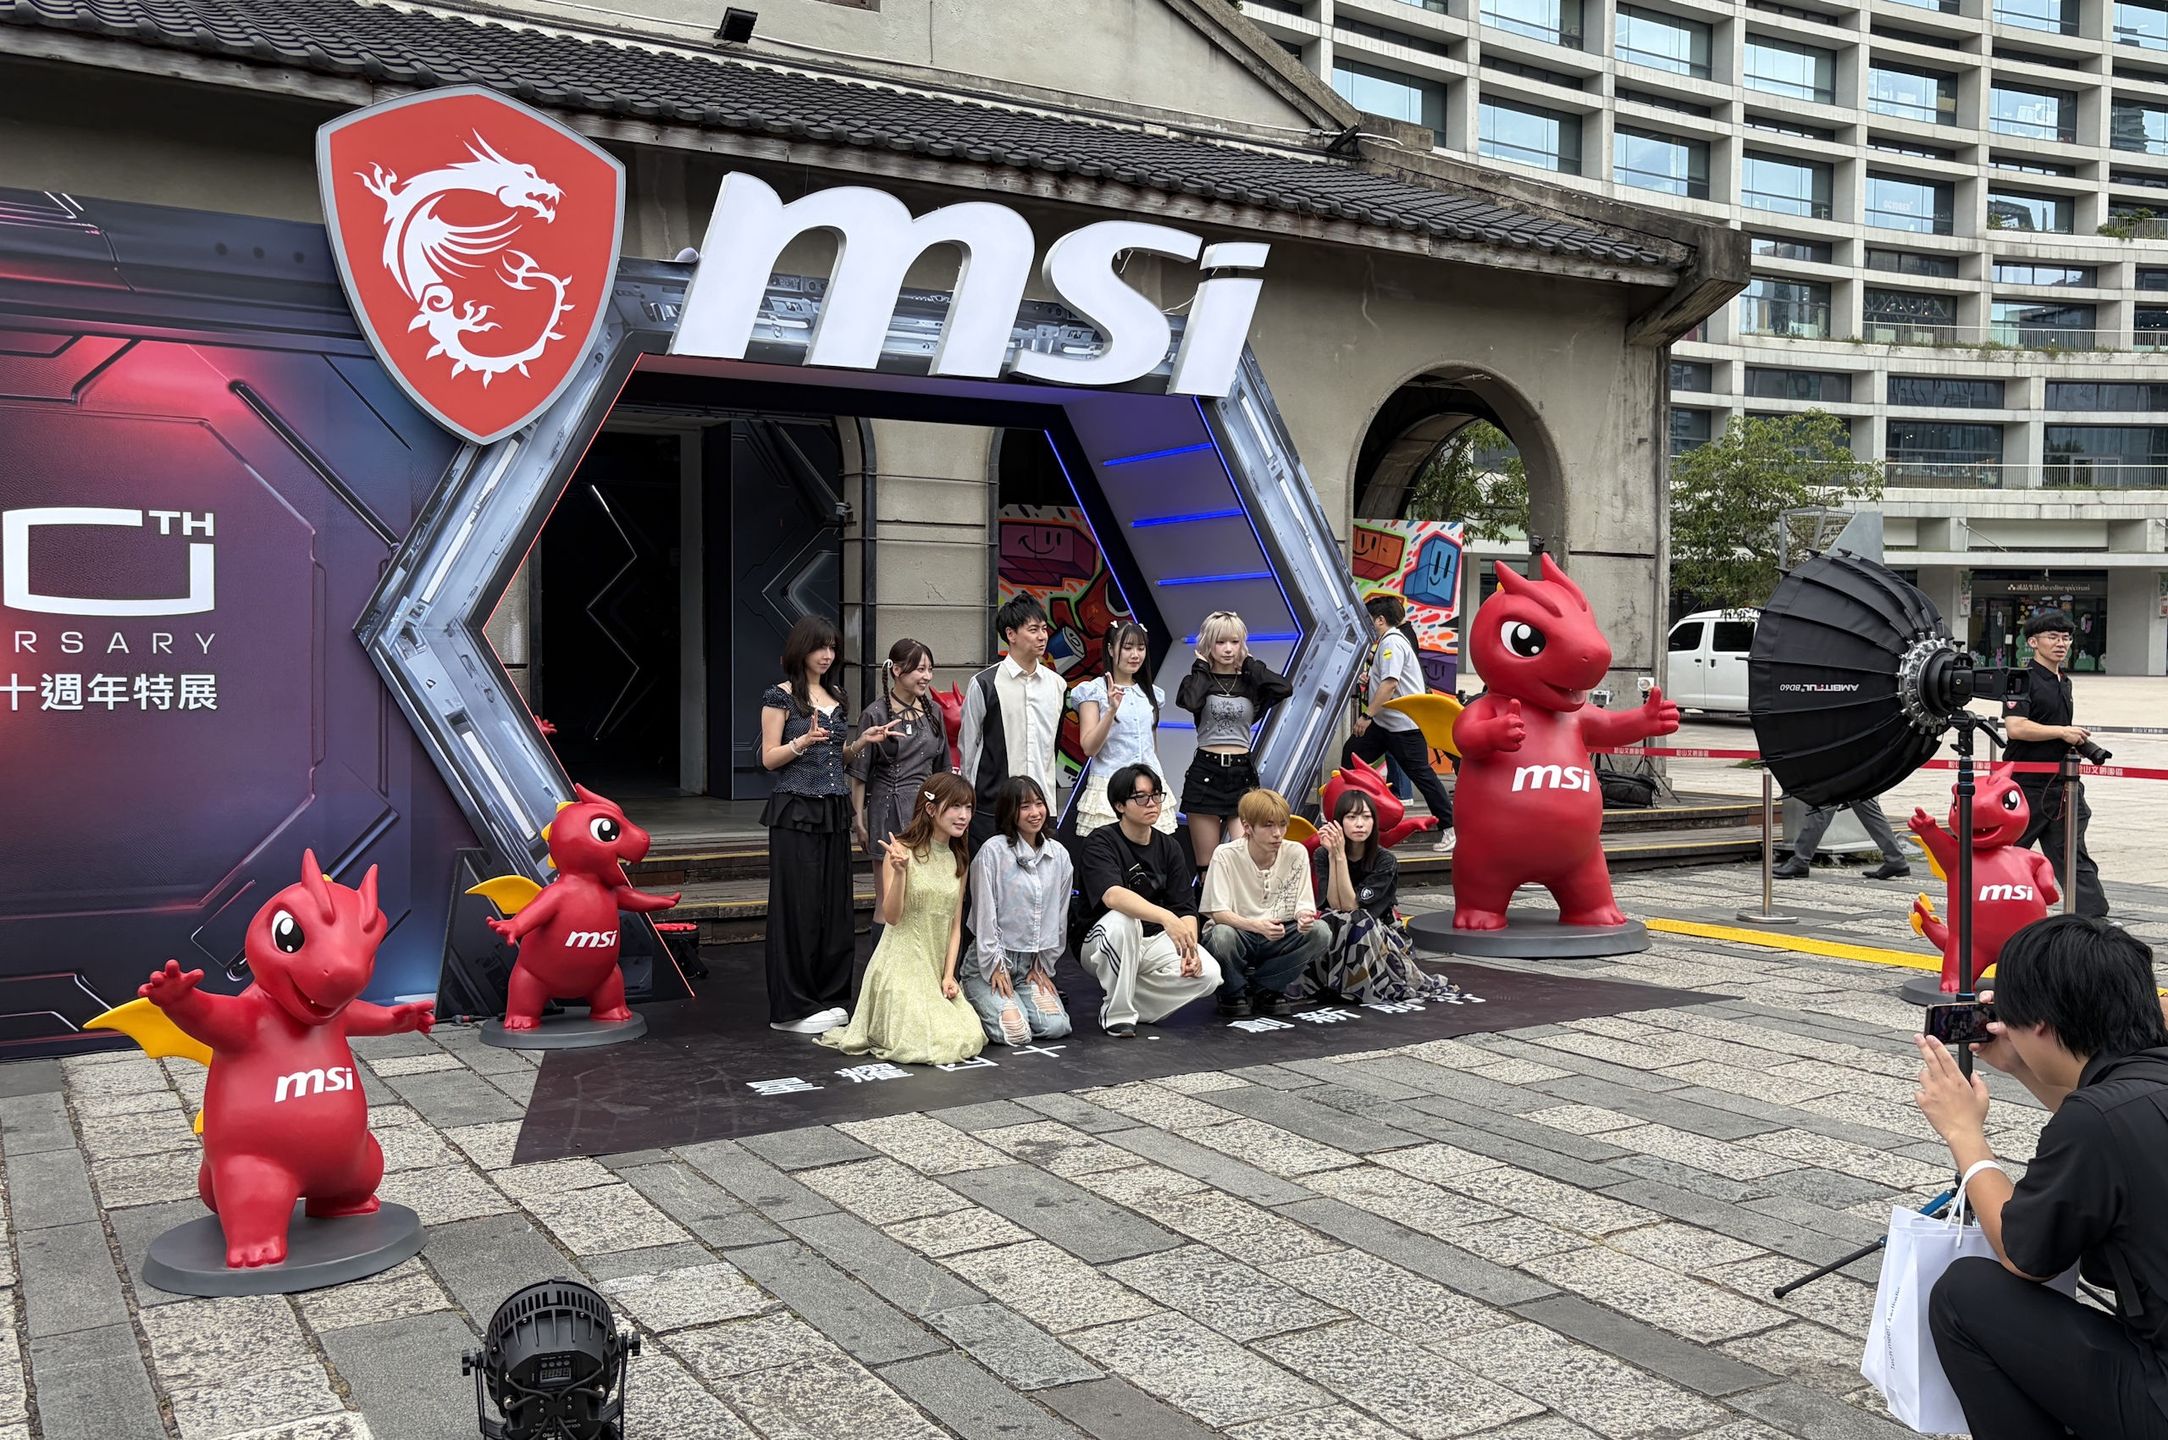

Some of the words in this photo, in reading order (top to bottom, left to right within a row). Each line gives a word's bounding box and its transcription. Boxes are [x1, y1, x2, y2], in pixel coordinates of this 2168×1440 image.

[667, 170, 1271, 398] msi
[0, 673, 218, 712] 十週年特展
[1779, 683, 1801, 692] BD60
[1511, 764, 1591, 793] msi
[1978, 884, 2034, 901] msi
[565, 929, 617, 948] msi
[274, 1066, 354, 1103] msi
